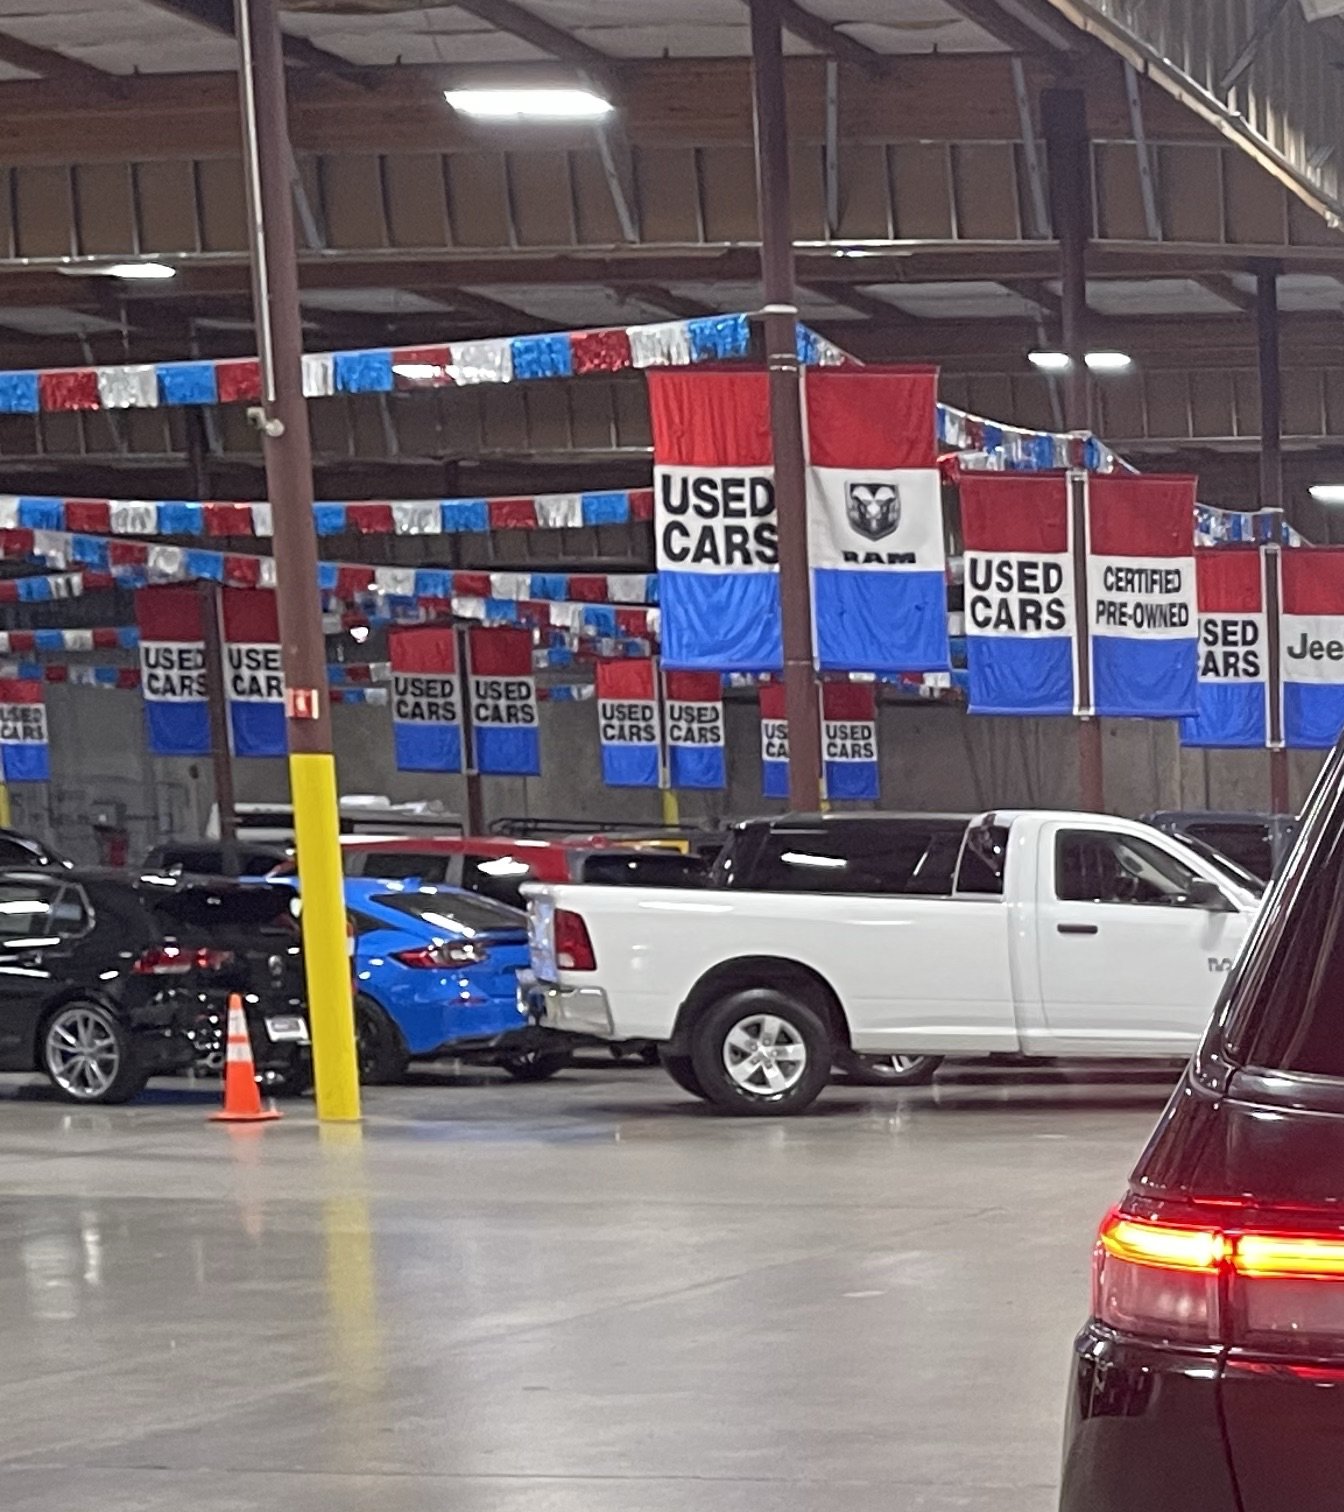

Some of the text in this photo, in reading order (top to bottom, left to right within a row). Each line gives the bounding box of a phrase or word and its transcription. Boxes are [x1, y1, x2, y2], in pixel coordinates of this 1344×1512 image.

[661, 473, 777, 520] USED
[662, 520, 780, 567] CARS
[841, 550, 917, 566] RAM
[969, 557, 1064, 595] USED
[1103, 565, 1183, 594] CERTIFIED
[970, 595, 1067, 632] CARS
[1095, 599, 1190, 629] PRE-OWNED
[1202, 618, 1259, 648] SED
[143, 647, 206, 671] USED
[226, 647, 281, 671] USE
[1200, 650, 1261, 678] ARS
[232, 674, 284, 698] CAR
[394, 676, 455, 699] USED
[474, 680, 532, 701] USED
[396, 700, 457, 722] CARS
[474, 703, 535, 724] CARS
[602, 702, 654, 722] USED
[669, 703, 720, 724] USED
[602, 723, 656, 743] CARS
[669, 724, 721, 744] CARS
[826, 723, 873, 741] USED
[826, 742, 875, 760] CARS
